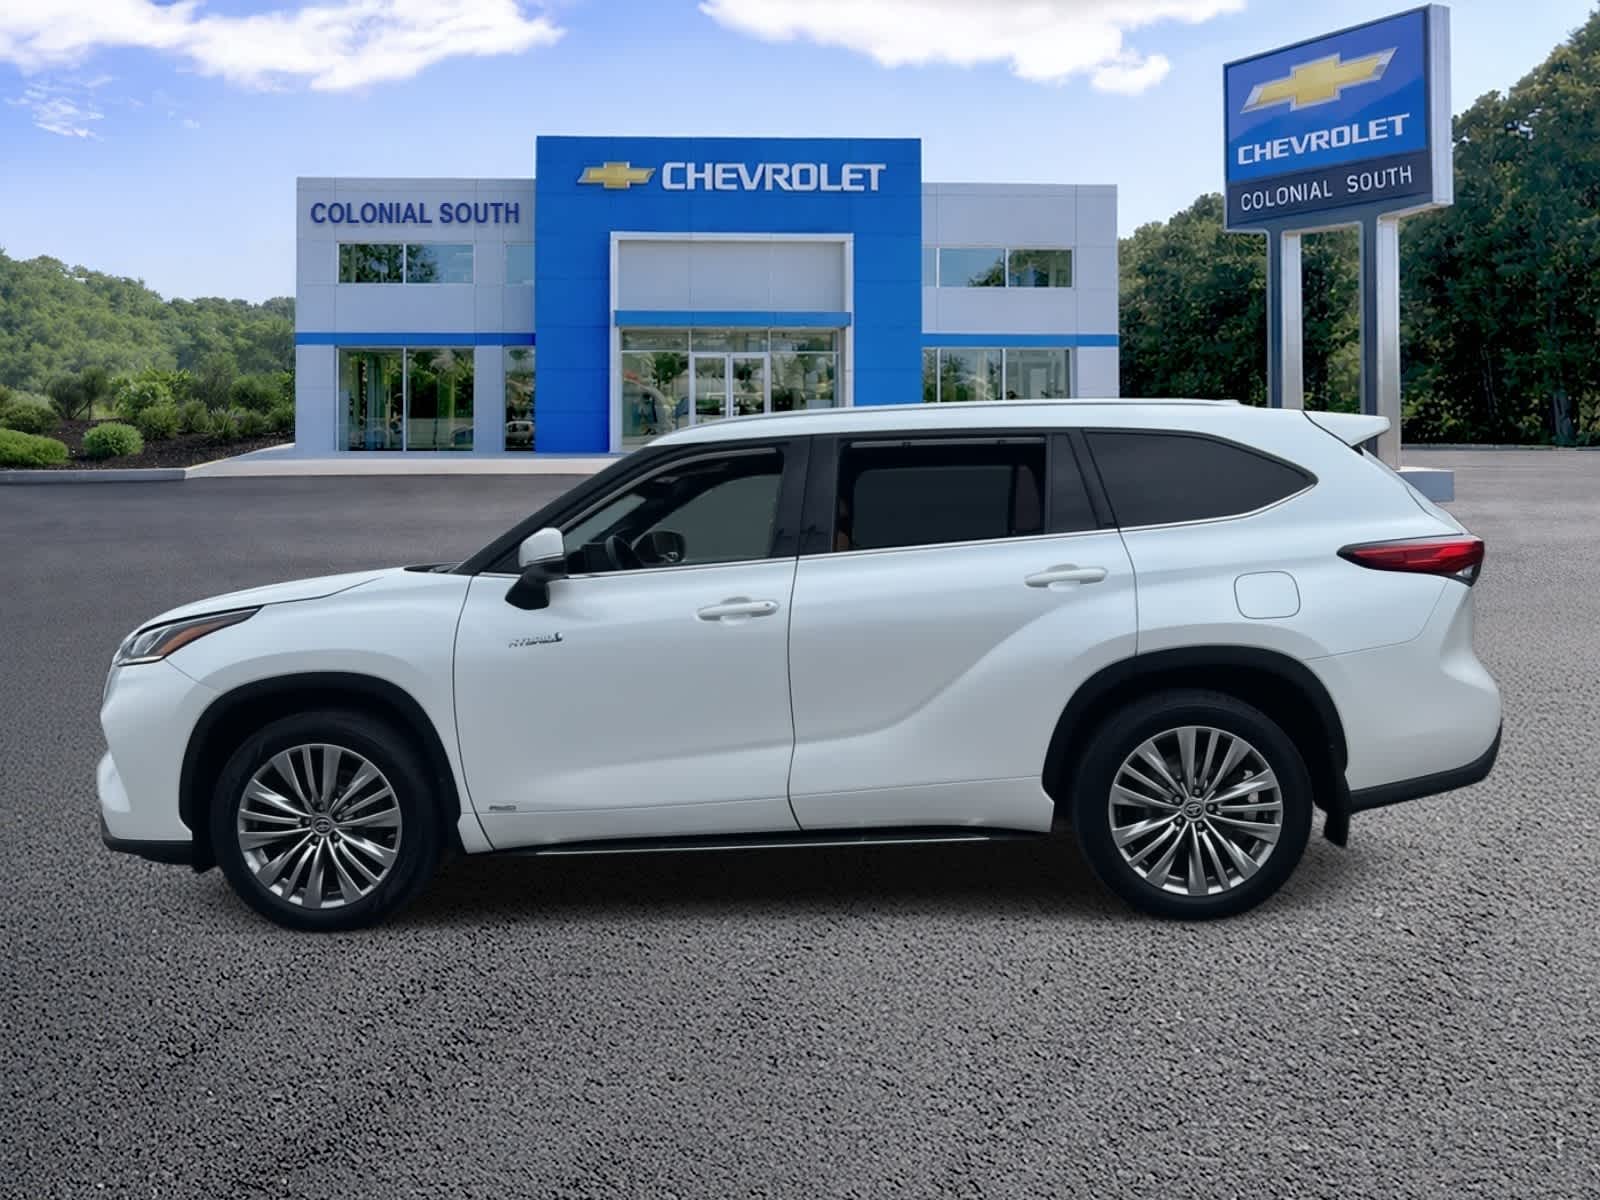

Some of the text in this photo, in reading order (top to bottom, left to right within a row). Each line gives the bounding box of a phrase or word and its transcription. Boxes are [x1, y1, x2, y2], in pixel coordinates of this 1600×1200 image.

[1238, 113, 1410, 165] CHEVROLET
[662, 162, 887, 191] CHEVROLET
[1241, 165, 1413, 211] COLONIAL SOUTH
[310, 202, 520, 224] COLONIAL SOUTH
